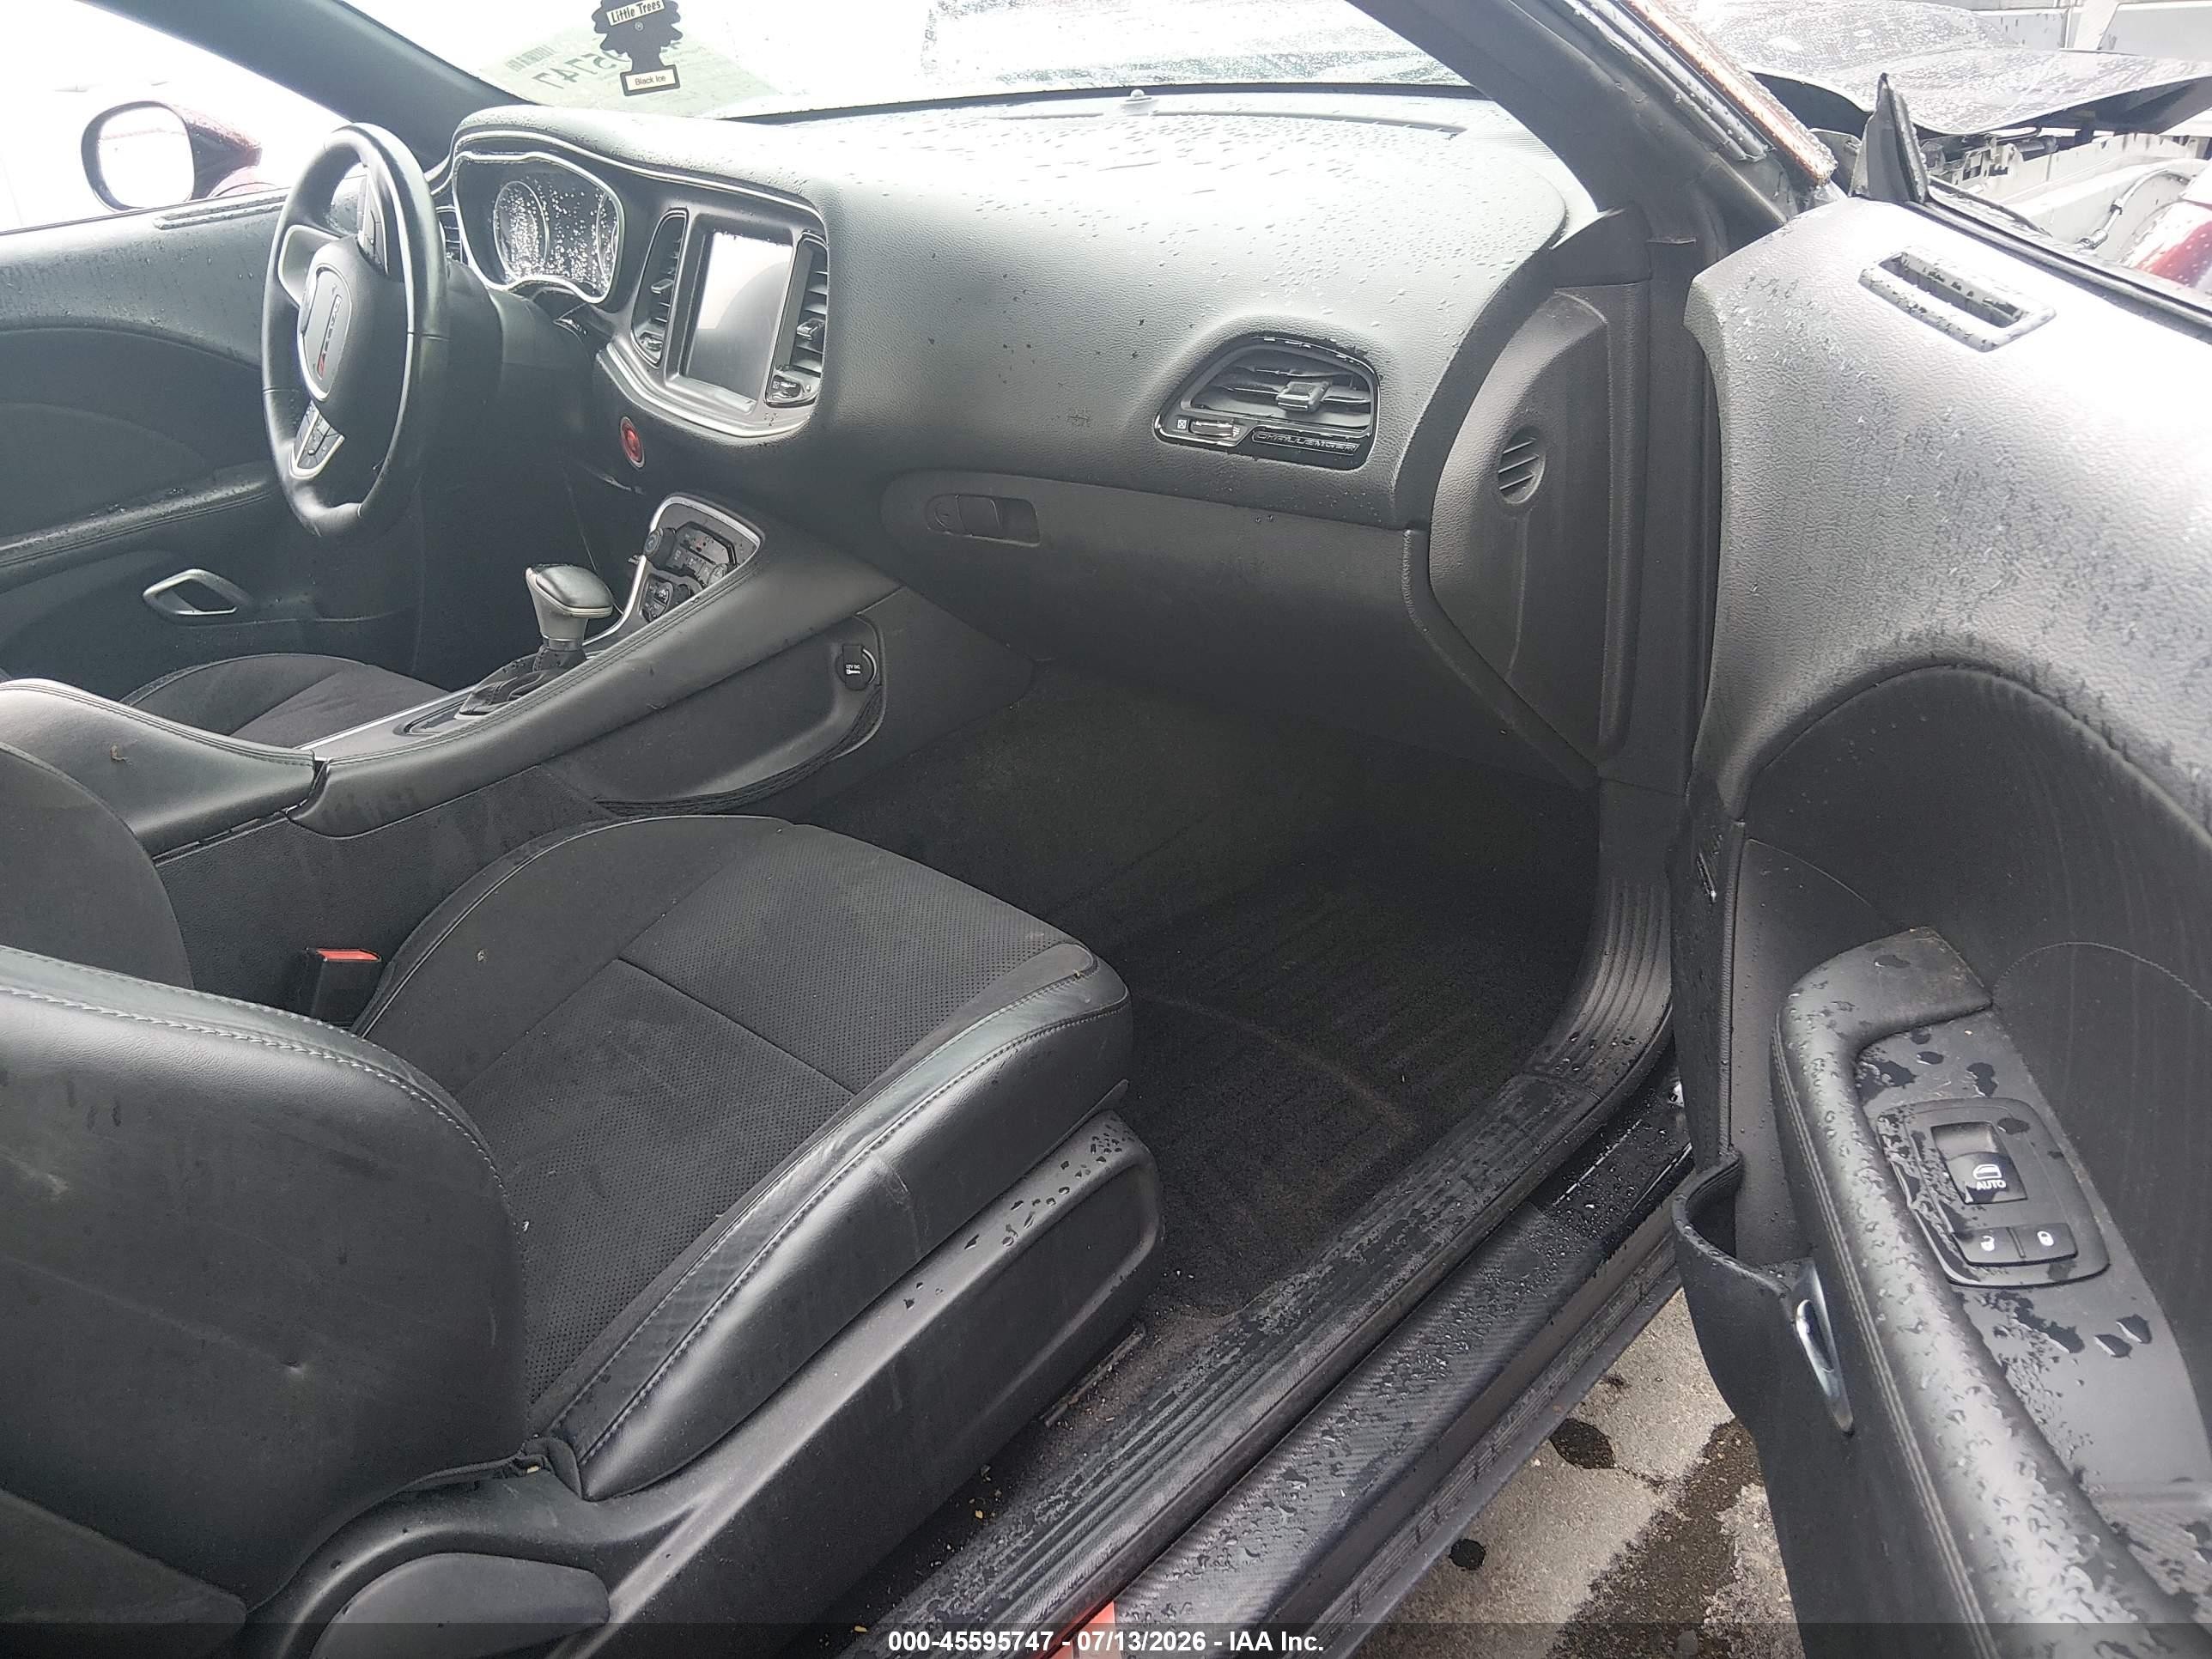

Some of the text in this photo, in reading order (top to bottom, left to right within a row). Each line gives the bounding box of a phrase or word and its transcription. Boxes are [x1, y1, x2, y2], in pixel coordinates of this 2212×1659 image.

[611, 0, 661, 23] Little Trees
[635, 75, 666, 86] Black Ice
[1256, 432, 1357, 452] CHALLENGER
[1977, 1179, 2007, 1190] AUTO
